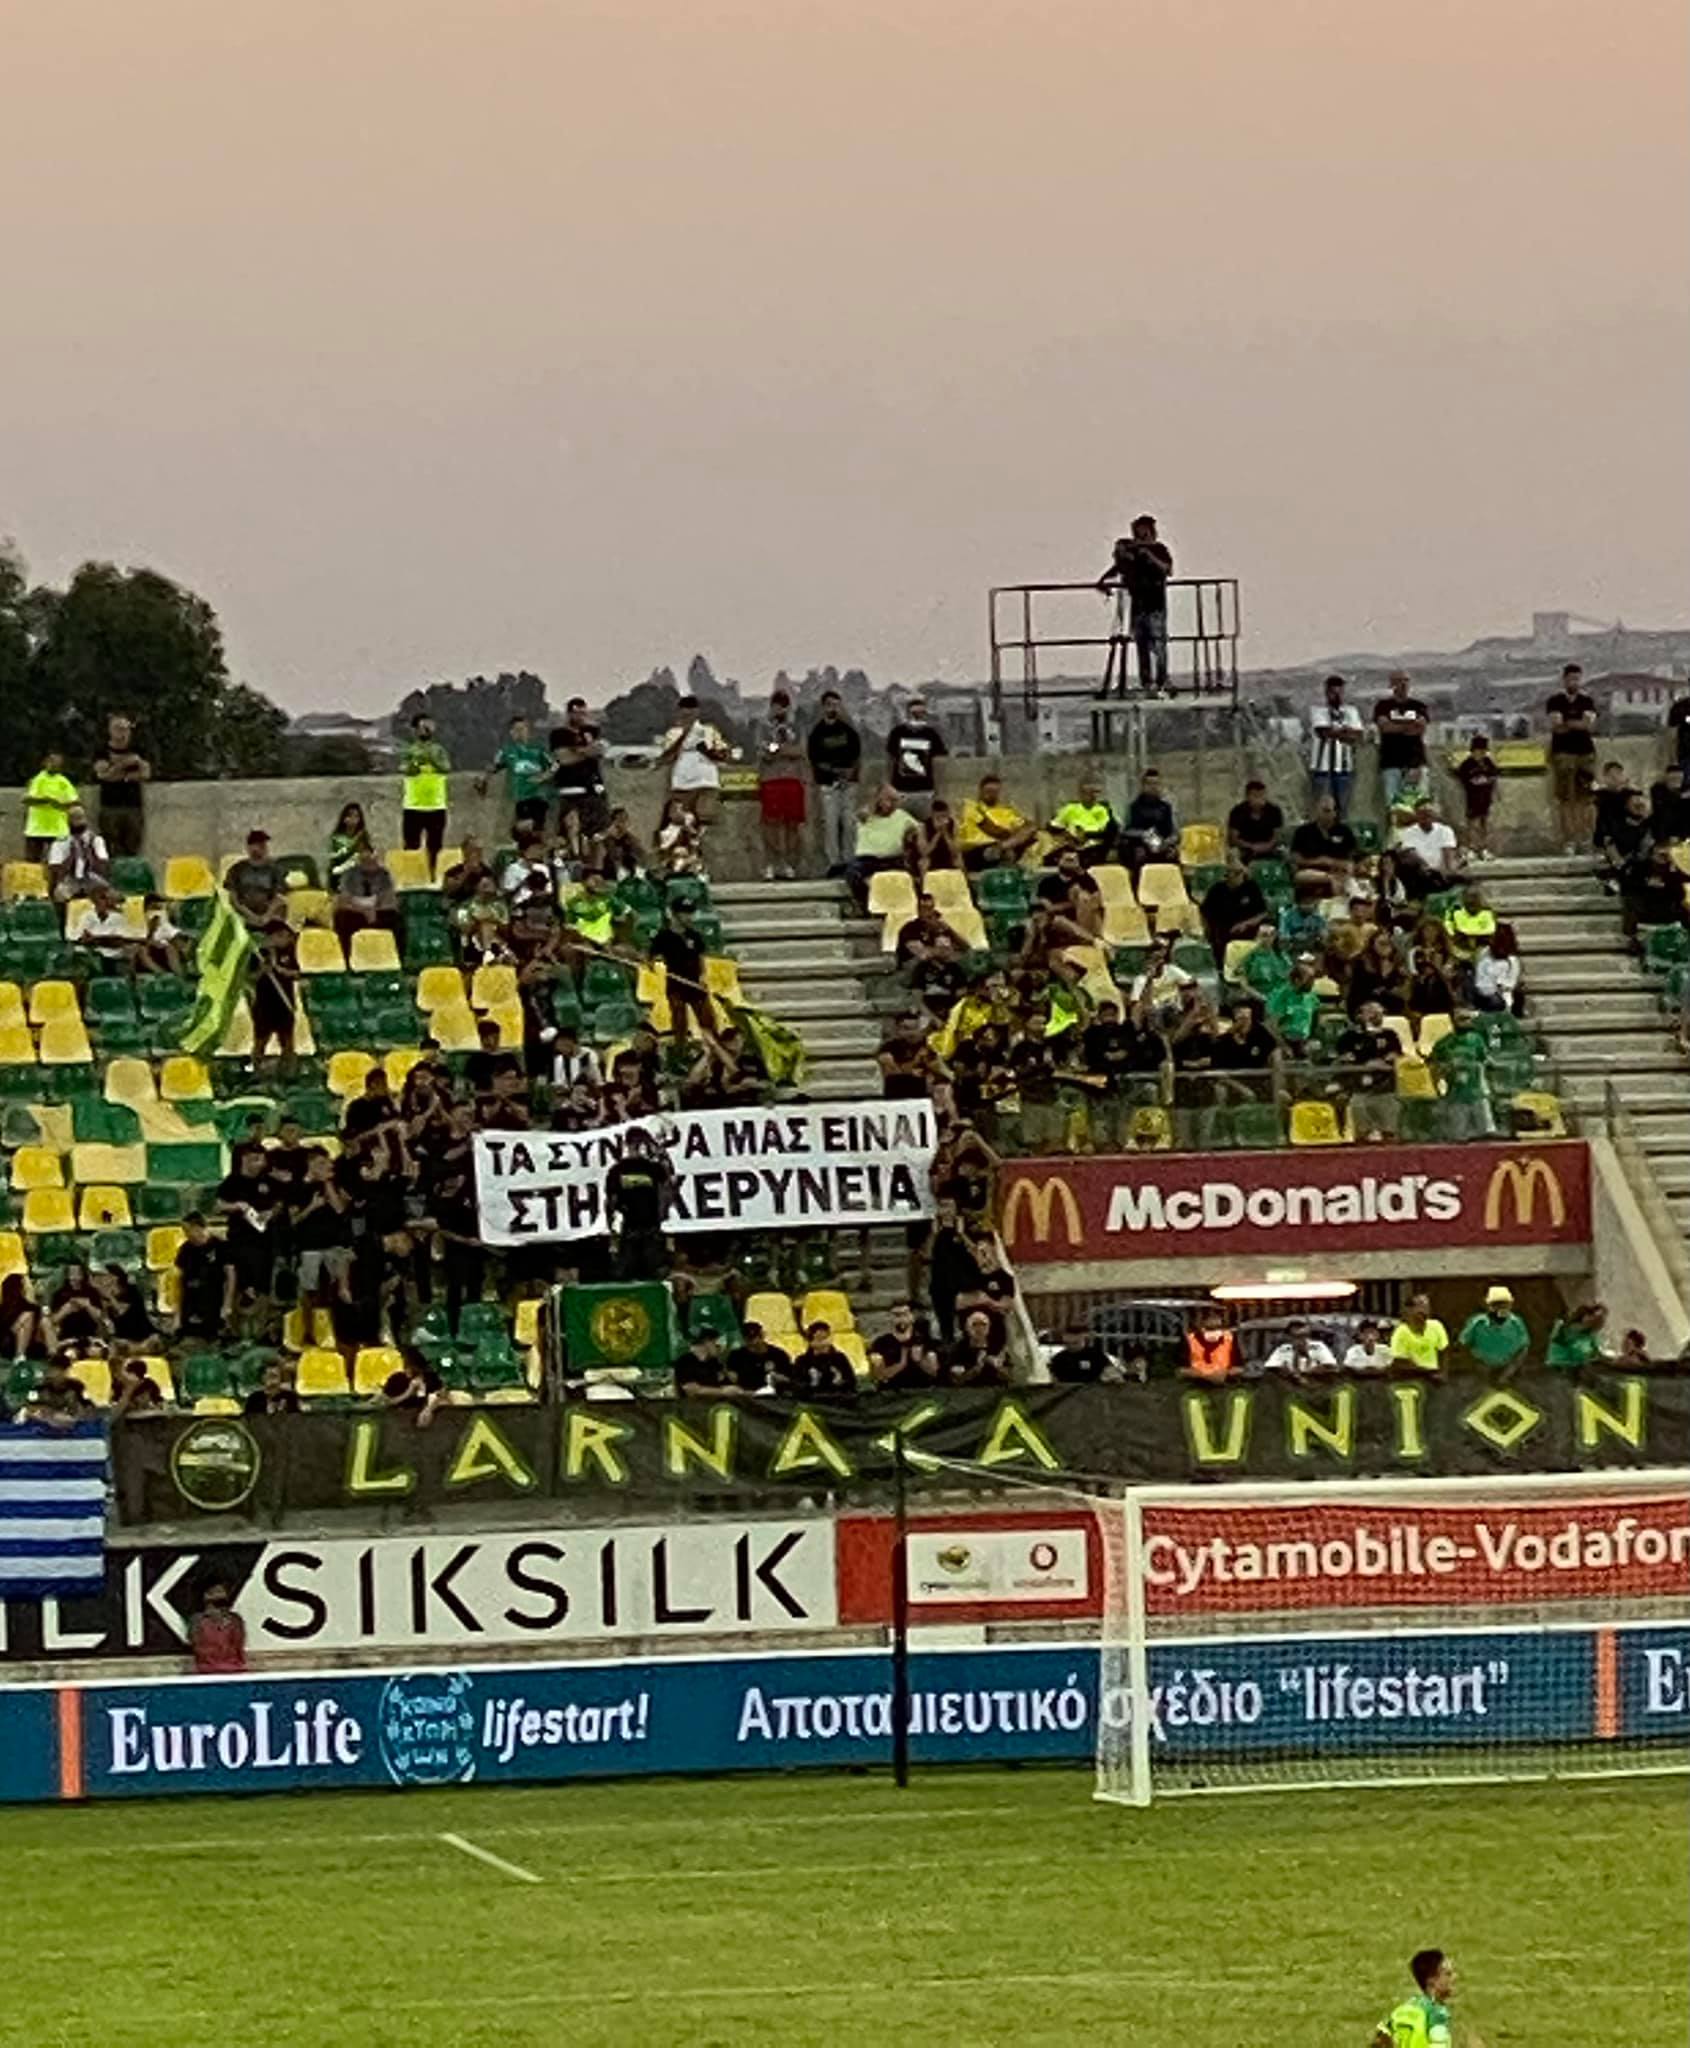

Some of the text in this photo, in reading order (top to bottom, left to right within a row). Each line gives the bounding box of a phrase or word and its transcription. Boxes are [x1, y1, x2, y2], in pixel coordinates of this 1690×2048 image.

[486, 1140, 535, 1176] ΤΑ
[723, 1116, 813, 1157] ΜΑΣ
[821, 1111, 931, 1153] ΕΙΝΑΙ
[1105, 1174, 1462, 1233] McDonald's
[1188, 1380, 1645, 1463] UNION
[261, 1530, 809, 1640] SIKSILK
[107, 1699, 362, 1775] EuroLife
[482, 1692, 650, 1764] lifestart!
